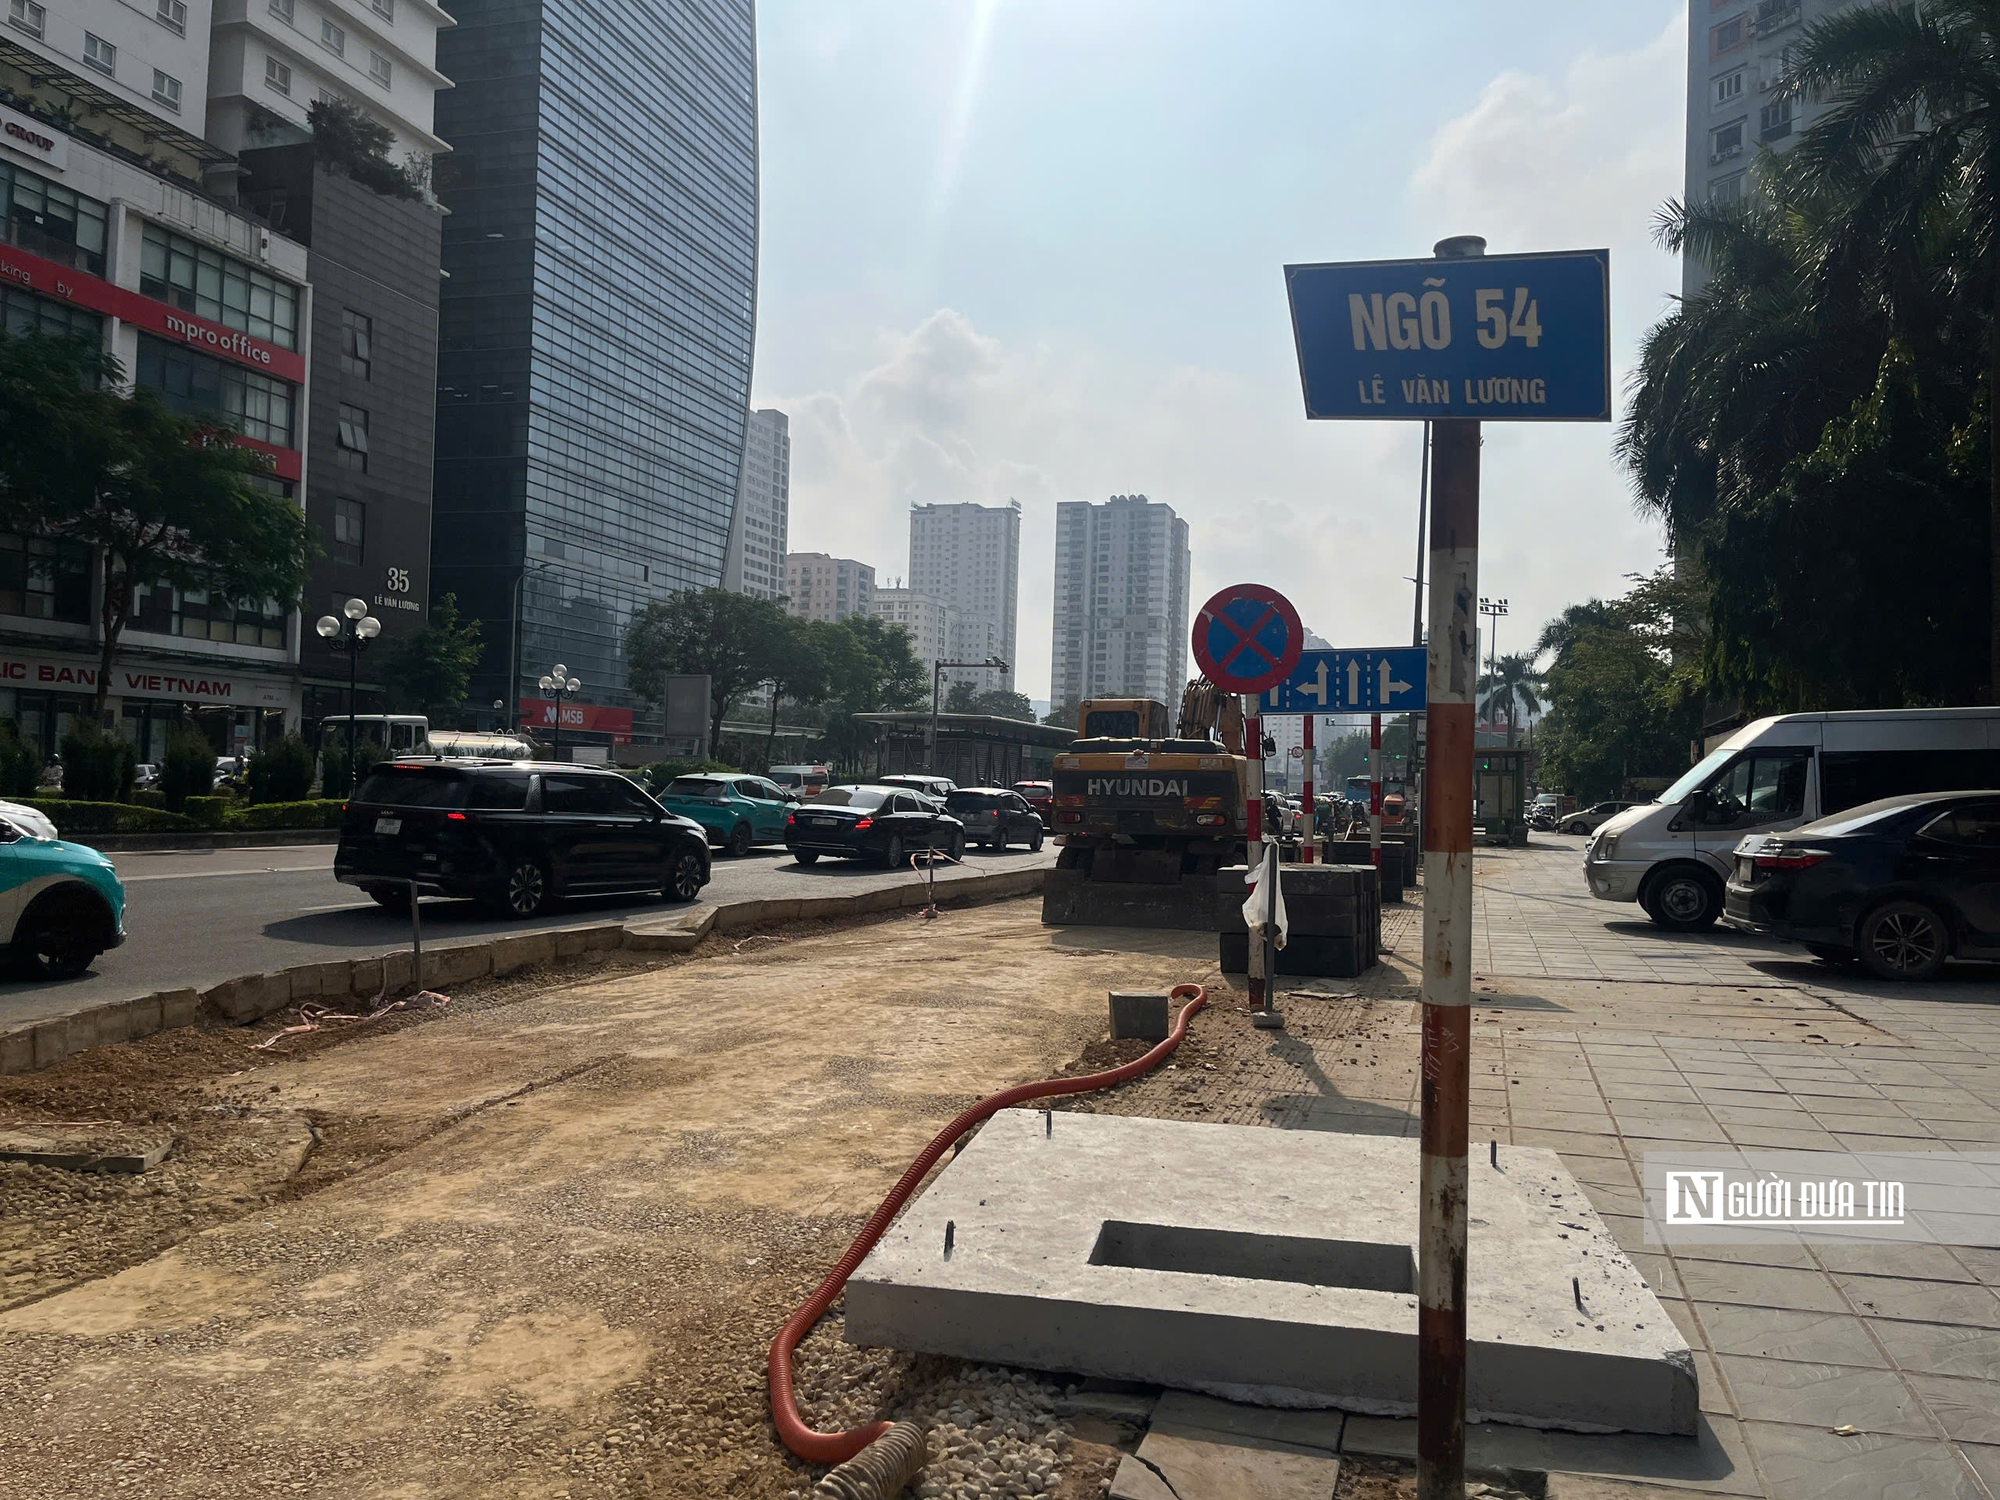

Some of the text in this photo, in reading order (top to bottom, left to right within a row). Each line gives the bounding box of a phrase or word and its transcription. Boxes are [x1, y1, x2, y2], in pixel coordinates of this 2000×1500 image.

[5, 122, 55, 151] GROUP
[57, 280, 74, 298] by
[1348, 277, 1542, 350] NGÕ 54
[1358, 373, 1546, 404] LÊ VĂN LƯƠNG
[387, 567, 410, 593] 35
[0, 662, 231, 697] IC BAN VIETNAM
[562, 709, 583, 724] MSB
[1087, 779, 1188, 796] HYUNDAI
